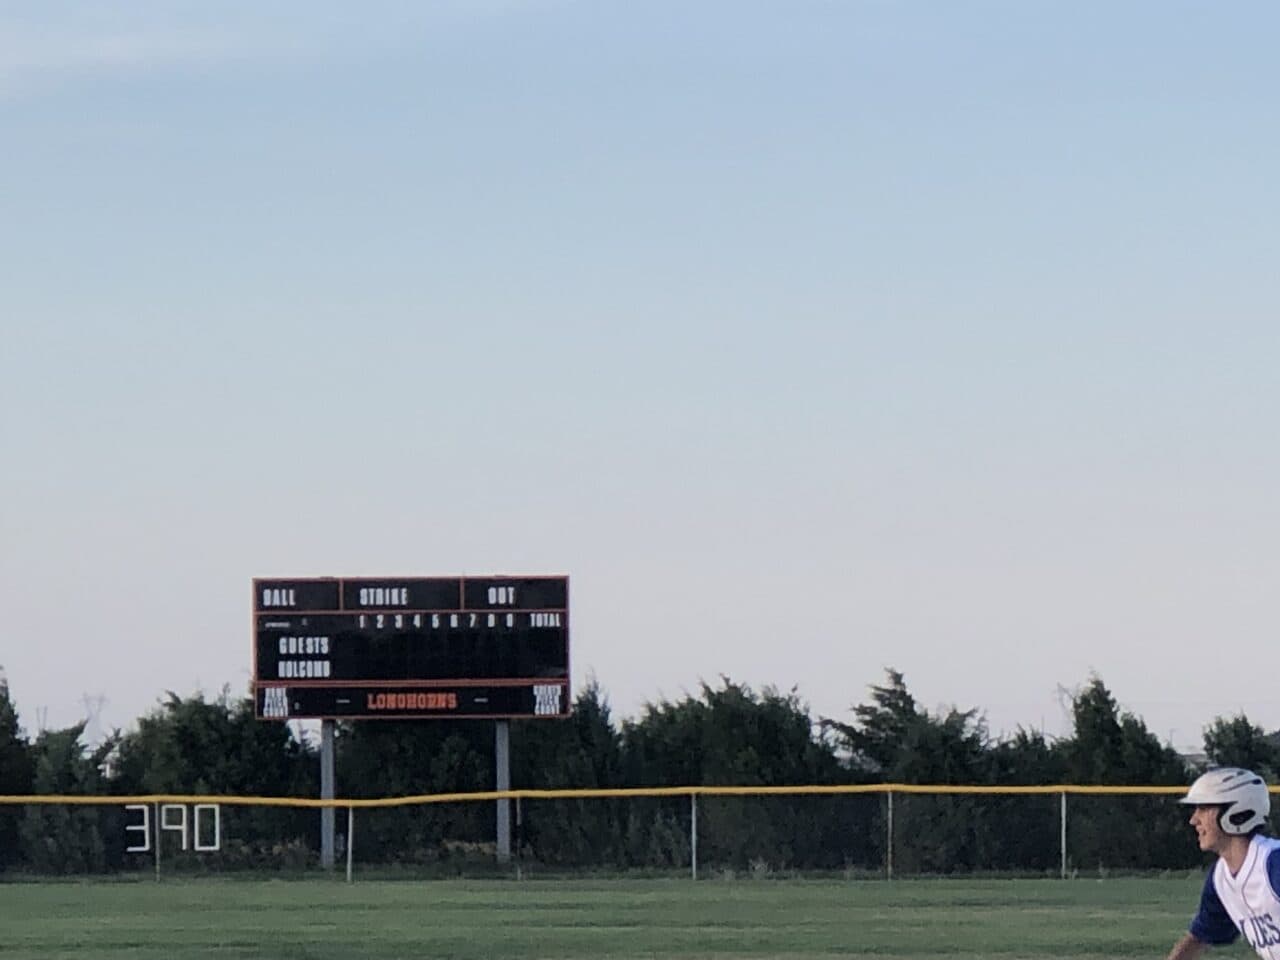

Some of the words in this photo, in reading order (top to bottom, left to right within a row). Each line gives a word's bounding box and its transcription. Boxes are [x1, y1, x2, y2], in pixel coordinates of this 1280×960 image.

[262, 588, 296, 606] BALL
[359, 587, 408, 606] STRIKE
[487, 586, 515, 605] OUT
[358, 614, 366, 629] 1
[376, 614, 385, 629] 2
[394, 614, 403, 629] 3
[412, 613, 421, 628] 4
[431, 613, 440, 628] 5
[469, 613, 477, 628] 7
[529, 612, 561, 628] TOTAL
[278, 636, 329, 655] GUESTS
[125, 804, 220, 852] 390
